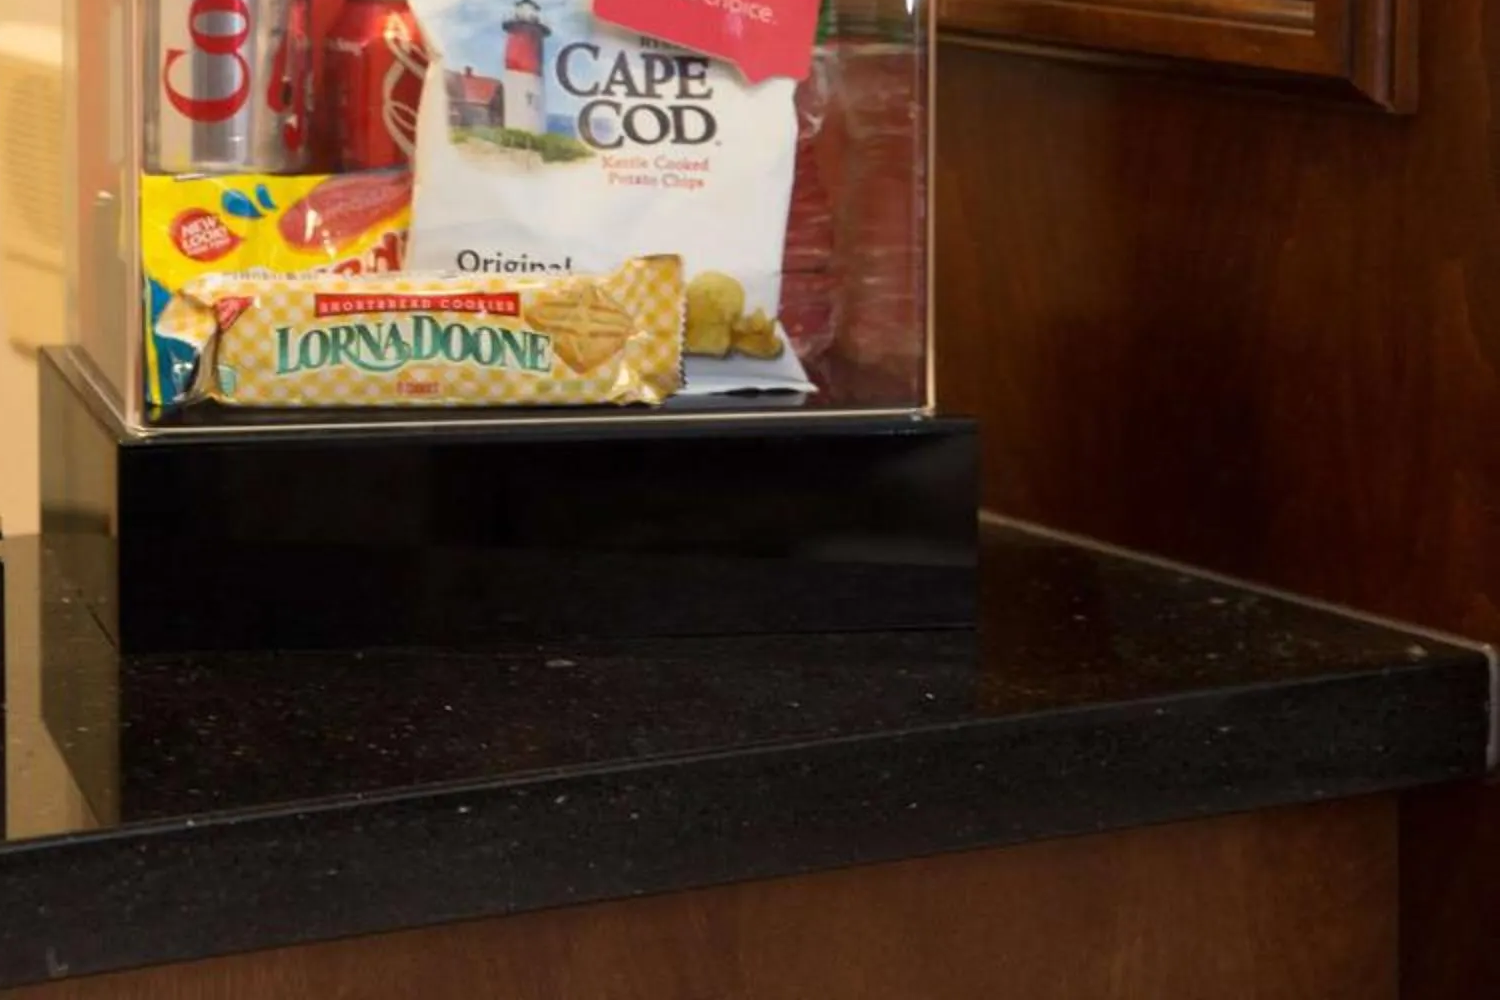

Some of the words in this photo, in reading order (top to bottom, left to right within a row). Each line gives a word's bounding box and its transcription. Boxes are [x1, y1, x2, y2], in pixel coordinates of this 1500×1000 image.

[555, 42, 714, 99] CAPE
[578, 99, 717, 150] COD
[602, 155, 649, 170] Kettle
[654, 155, 710, 172] Cooked
[608, 172, 657, 186] Potato
[662, 173, 705, 190] Chips
[318, 298, 432, 315] SHORTBREAD
[440, 298, 516, 314] COOKIES
[276, 321, 412, 376] LORNA
[411, 314, 553, 373] DOONE
